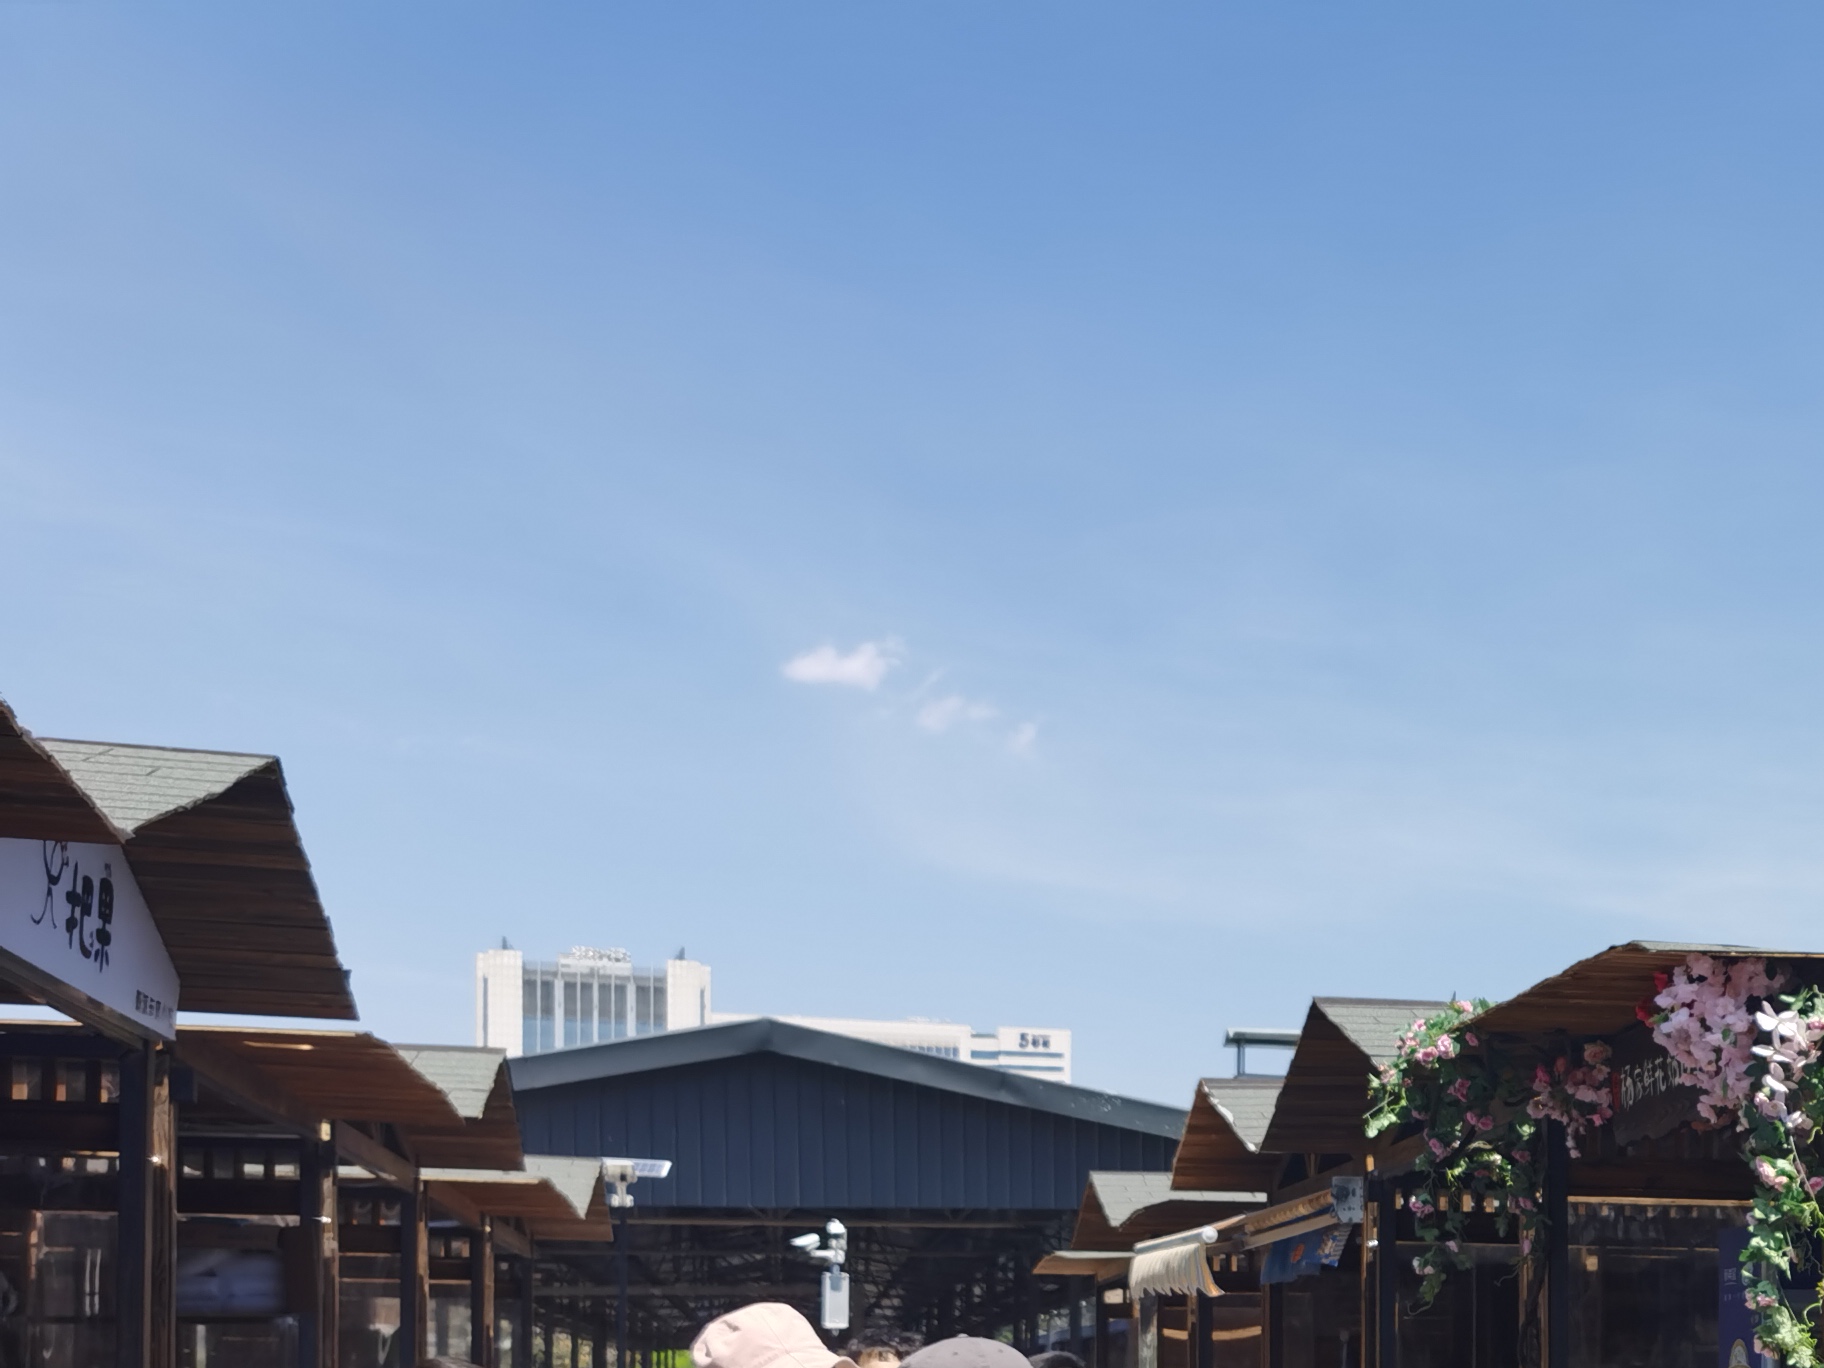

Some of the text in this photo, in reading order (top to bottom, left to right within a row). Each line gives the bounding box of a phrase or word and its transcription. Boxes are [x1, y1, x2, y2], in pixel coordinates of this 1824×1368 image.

[1620, 1054, 1699, 1112] 杨家鲜花奶
